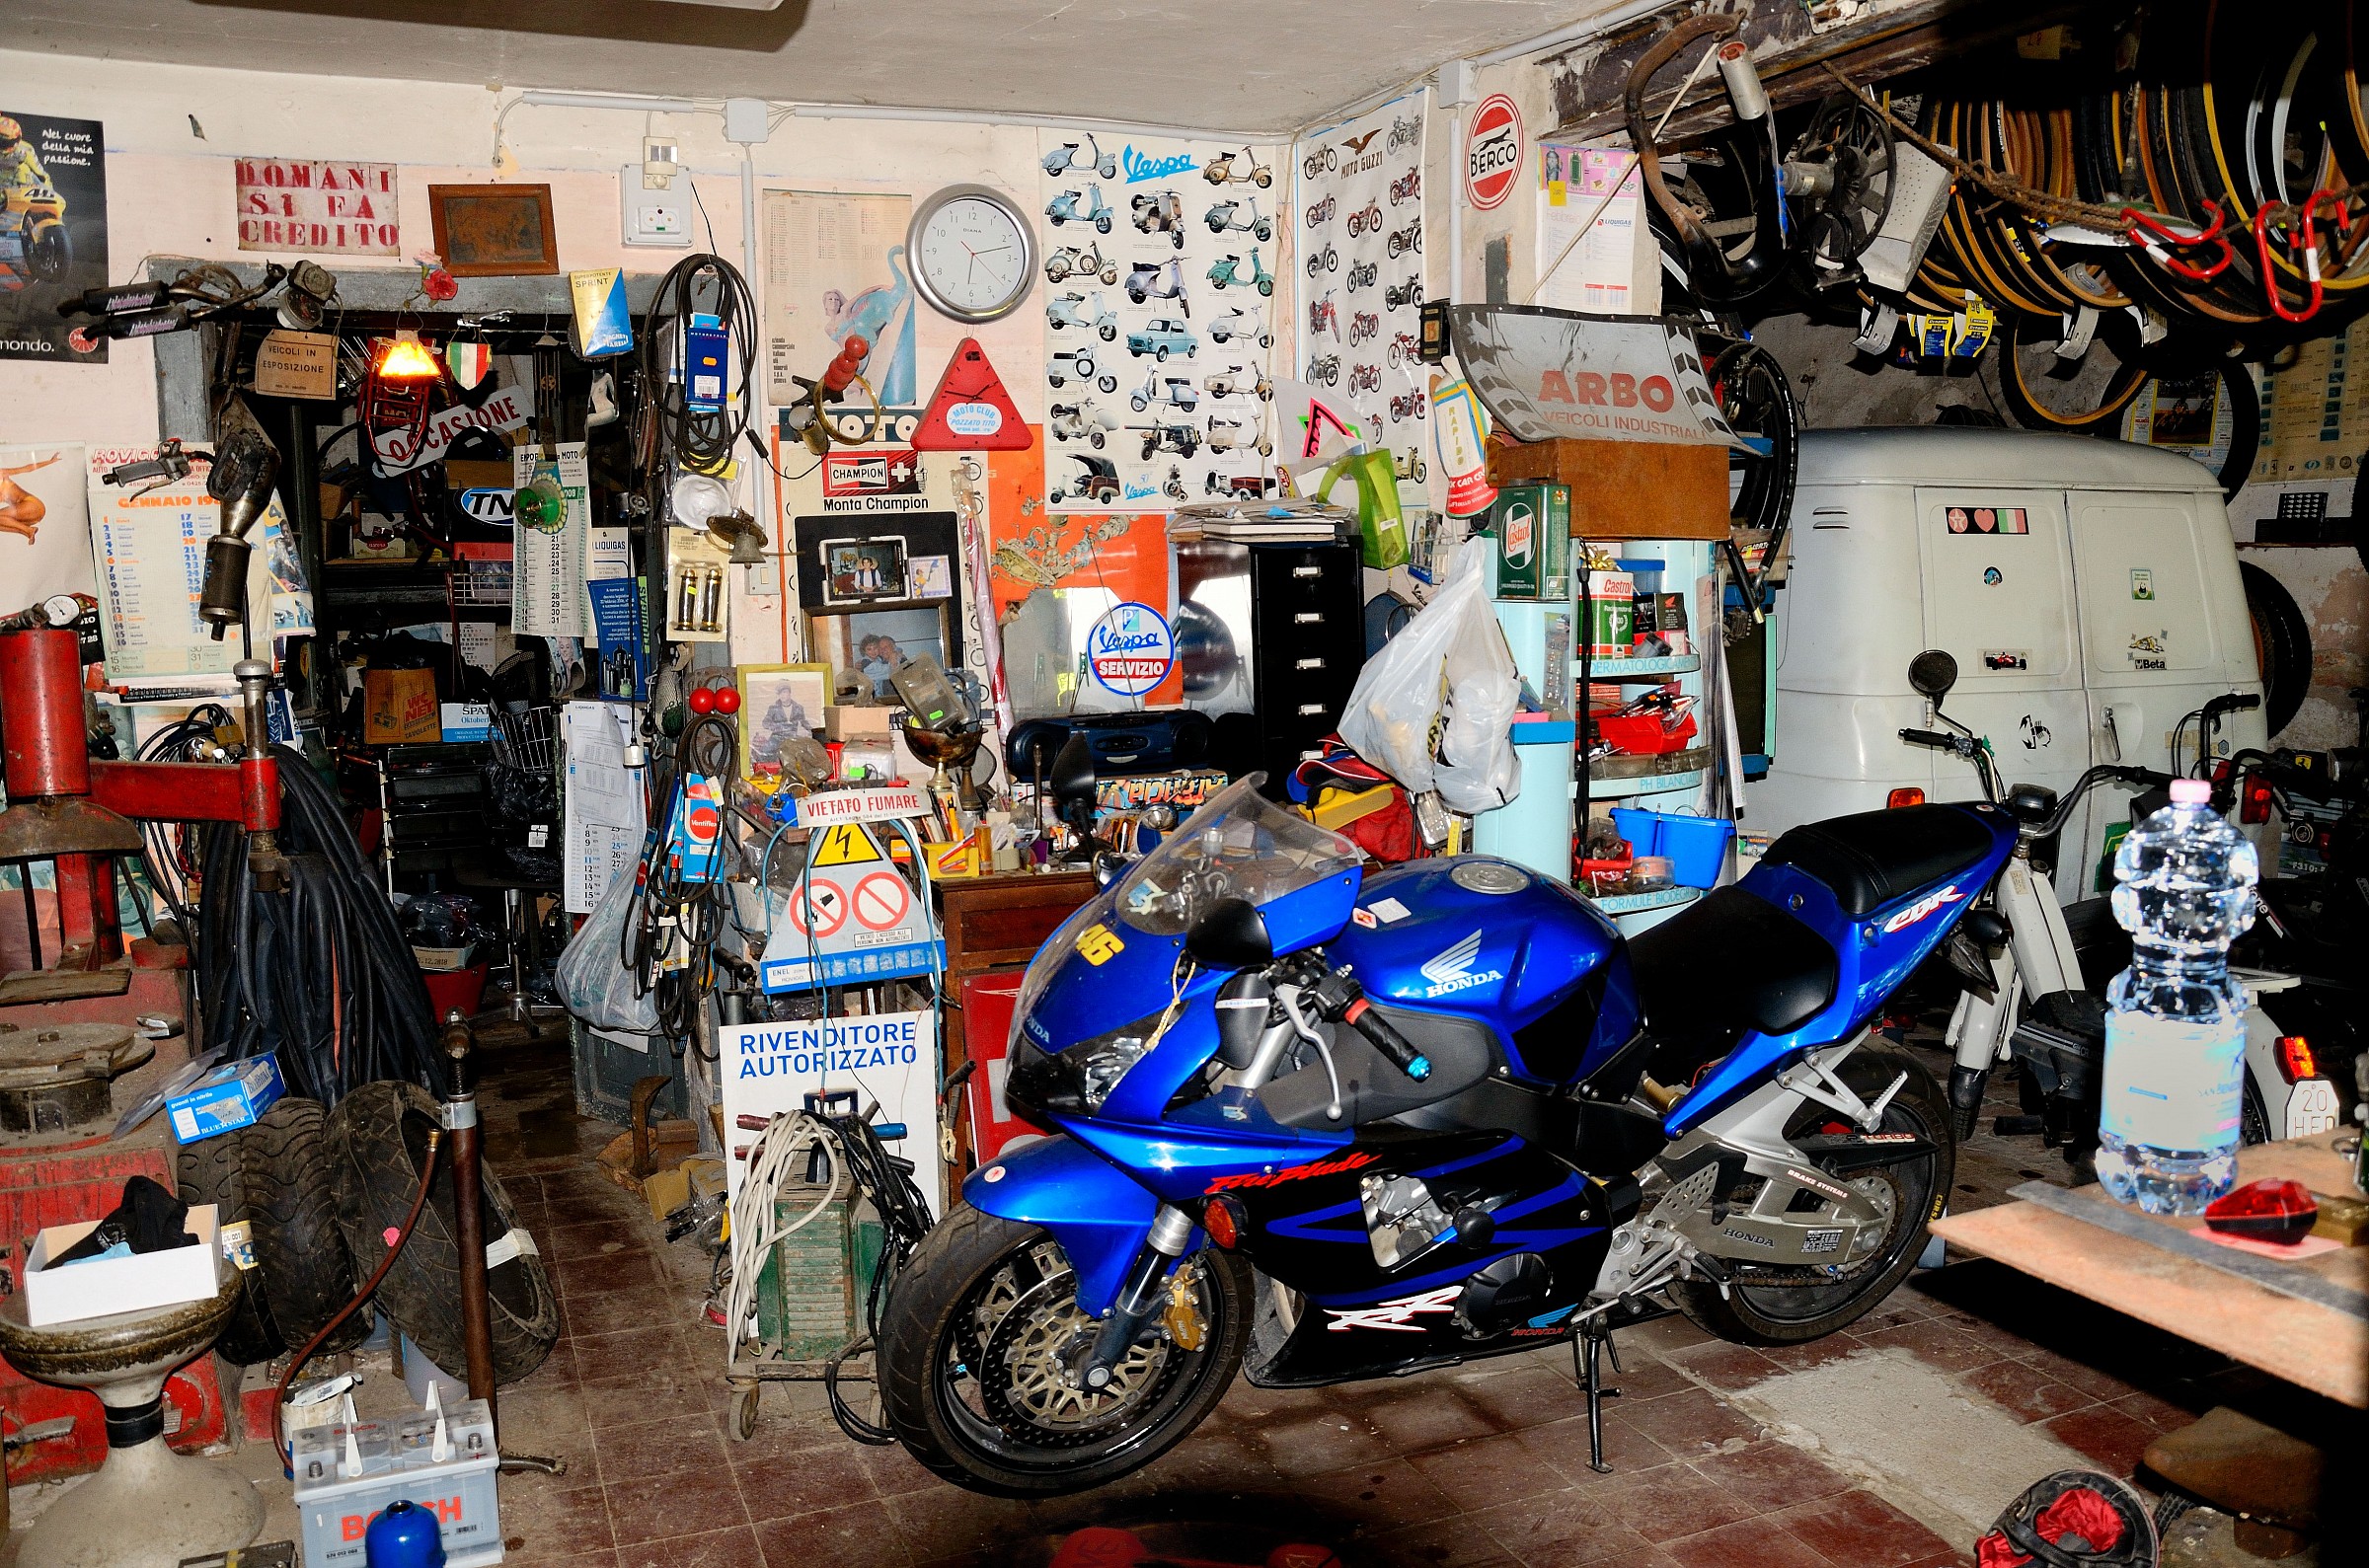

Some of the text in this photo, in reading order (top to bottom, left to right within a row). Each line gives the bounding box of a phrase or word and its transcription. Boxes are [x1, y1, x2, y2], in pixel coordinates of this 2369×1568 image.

[42, 128, 92, 143] Nel cuore
[41, 141, 94, 155] della mia
[1122, 143, 1200, 185] Vespa
[1340, 150, 1383, 181] MOTO GUZZI
[1469, 141, 1517, 179] BERCO
[235, 160, 390, 192] DOMANI
[249, 192, 376, 219] SI FA
[239, 219, 400, 247] CREDITO
[575, 277, 609, 288] SPRINT
[951, 282, 955, 291] 7
[267, 345, 317, 357] VEICOLI IN
[263, 359, 325, 374] ESPOSIZIONE
[1537, 369, 1675, 413] ARBO
[953, 405, 996, 418] MOTO CLUB
[1543, 411, 1610, 428] VEICOLI
[1448, 406, 1466, 467] RAPIDO
[562, 450, 578, 460] MOTO
[832, 468, 884, 481] CHAMPION
[1457, 475, 1473, 487] CAR
[1124, 483, 1159, 501] Vespa
[117, 496, 192, 508] GENNAIO
[823, 496, 930, 512] Monta Champion
[1507, 517, 1531, 553] Castrol
[594, 541, 626, 551] LIQUIGAS
[1603, 578, 1633, 594] Castrol
[639, 586, 650, 644] LIQUIGAS
[1100, 625, 1164, 653] Vespa
[1099, 661, 1165, 676] SERVIZIO
[2143, 658, 2166, 669] Beta
[407, 691, 428, 709] WC
[405, 701, 434, 722] NET
[405, 722, 437, 739] TAVOLETTE
[1640, 779, 1654, 789] PH
[806, 794, 921, 818] VIETATO FUMARE
[1600, 892, 1652, 912] FORMULE
[1883, 884, 1966, 933] CBR
[1075, 922, 1124, 967] 46
[772, 967, 790, 977] ENEL
[1424, 969, 1504, 999] HONDA
[739, 1021, 917, 1055] RIVENDITORE
[739, 1044, 918, 1080] AUTORIZZATO
[2302, 1089, 2328, 1112] 20
[200, 1116, 247, 1135] BLUE STAR
[1862, 1131, 1916, 1144] TURBO
[1787, 1168, 1849, 1199] BRAKE SYSTEMS
[1722, 1227, 1776, 1249] HONDA
[1510, 1326, 1565, 1337] HONDA
